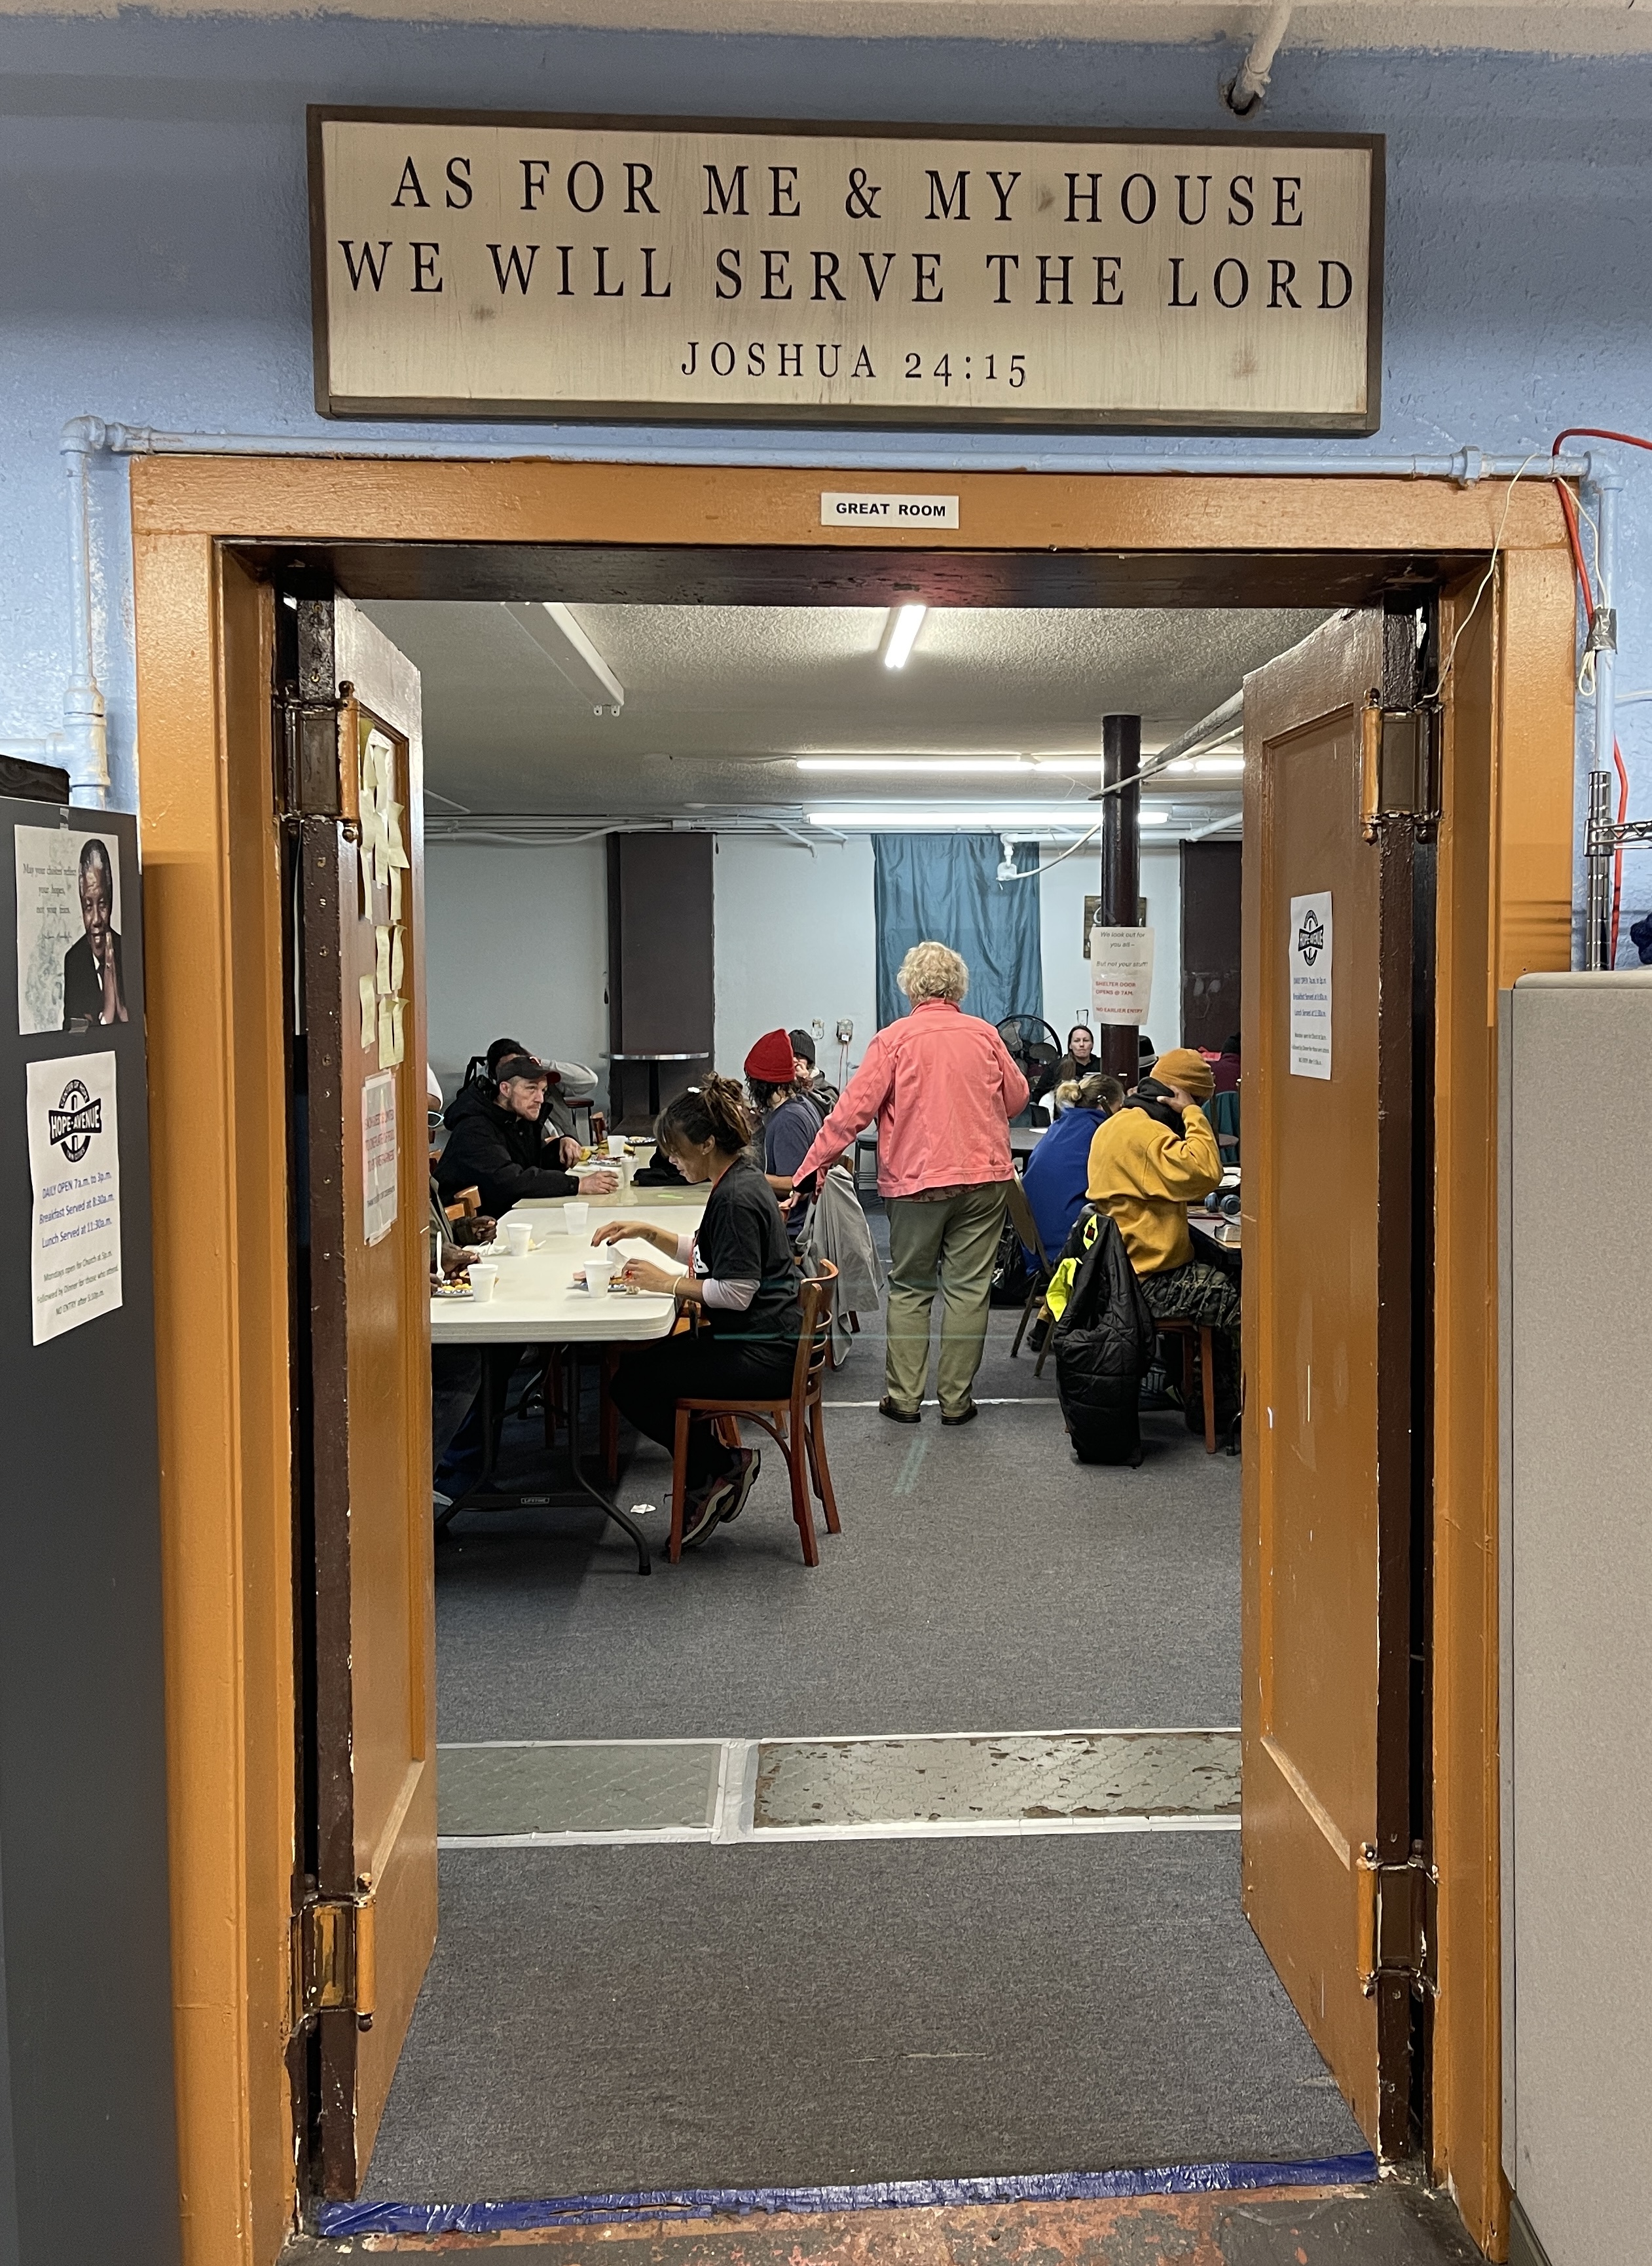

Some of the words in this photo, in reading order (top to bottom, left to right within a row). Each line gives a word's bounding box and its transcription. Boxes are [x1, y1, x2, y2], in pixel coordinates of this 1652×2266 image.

[391, 156, 473, 210] AS
[519, 159, 659, 213] FOR
[703, 164, 800, 217] ME
[845, 167, 881, 219] &
[925, 170, 1021, 221] MY
[1064, 172, 1304, 227] HOUSE
[338, 240, 443, 293] WE
[486, 244, 671, 298] WILL
[715, 247, 944, 303] SERVE
[985, 253, 1124, 306] THE
[1167, 257, 1353, 309] LORD
[681, 341, 876, 379] JOSHUA
[905, 352, 1026, 388] 24:15
[835, 502, 890, 515] GREAT
[898, 504, 946, 517] ROOM
[42, 1184, 56, 1199] DAILY
[57, 1180, 73, 1194] OPEN
[66, 1199, 85, 1216] Served
[41, 1233, 59, 1249] Lunch
[60, 1224, 80, 1242] Served
